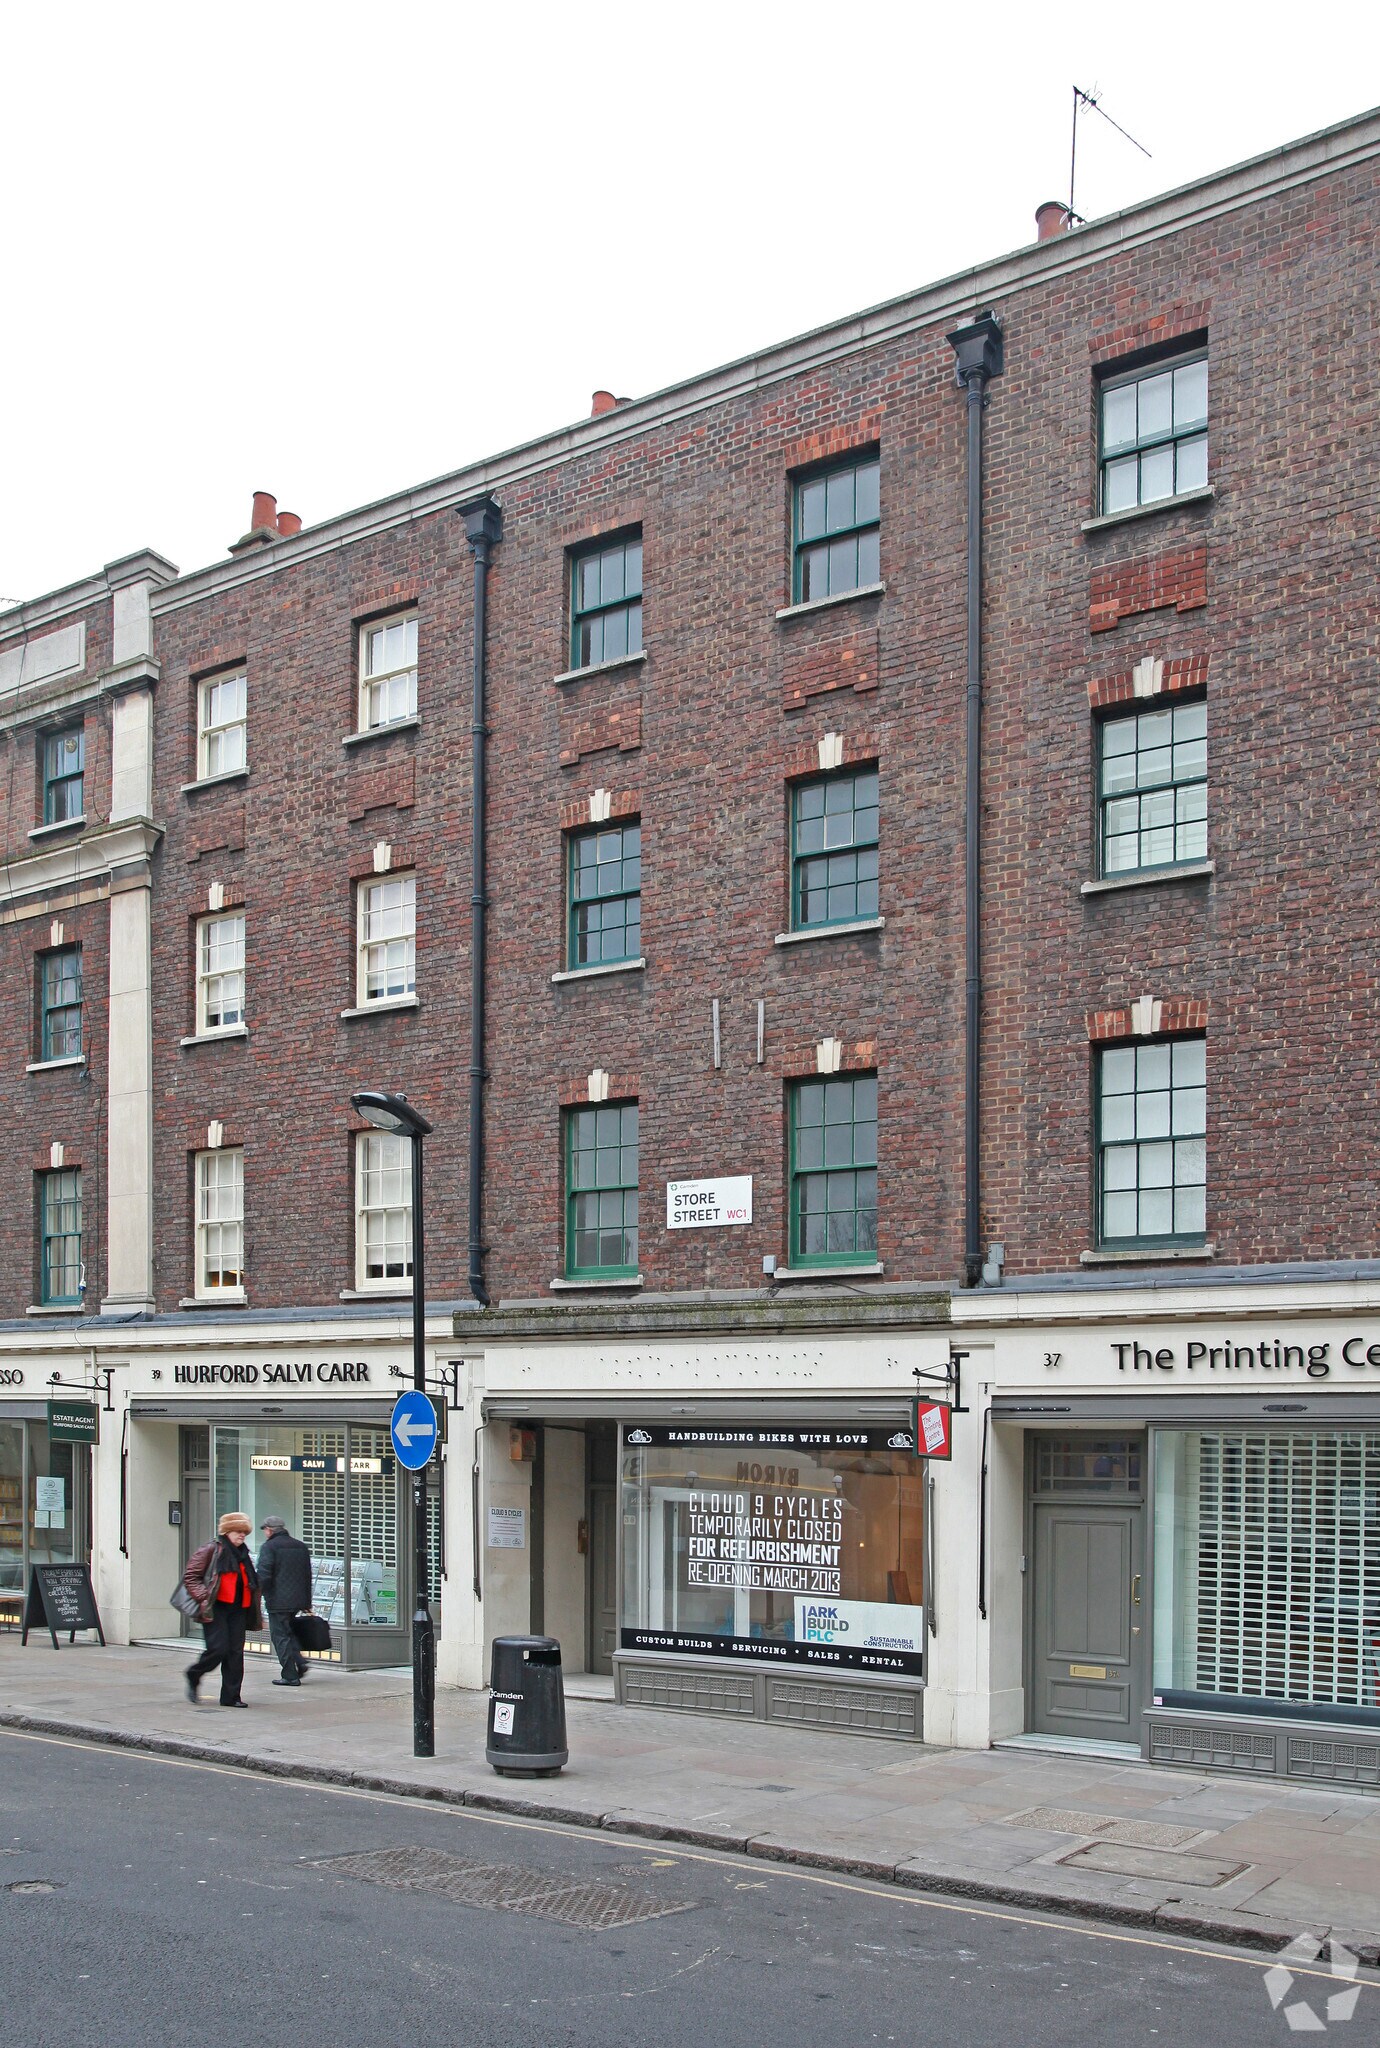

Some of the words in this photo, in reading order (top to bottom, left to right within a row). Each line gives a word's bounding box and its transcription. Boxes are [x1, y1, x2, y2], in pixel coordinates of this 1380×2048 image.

[674, 1192, 715, 1206] STORE
[673, 1208, 720, 1222] STREET
[726, 1209, 747, 1219] WC1
[1043, 1352, 1061, 1367] 37
[1110, 1341, 1175, 1370] The
[1187, 1339, 1329, 1378] Printing
[51, 1371, 60, 1380] 40
[151, 1369, 161, 1379] 39
[174, 1364, 258, 1383] HURFORD
[262, 1363, 312, 1382] SALVI
[316, 1362, 370, 1382] CARR
[388, 1364, 399, 1376] 39
[53, 1414, 74, 1422] ESTATE
[925, 1420, 941, 1432] Printing
[669, 1432, 754, 1442] HANDBUILDING
[759, 1433, 794, 1442] BIKES
[800, 1434, 829, 1443] WITH
[836, 1435, 868, 1444] LOVE
[927, 1431, 940, 1442] Centre
[252, 1459, 289, 1467] HURFORD
[302, 1460, 325, 1468] SALVI
[491, 1508, 504, 1516] CLOUD
[689, 1493, 744, 1515] CLOUD
[755, 1495, 764, 1516] 9
[774, 1497, 842, 1519] CYCLES
[690, 1514, 781, 1538] TEMPORARILY
[787, 1519, 842, 1543] CLOSED
[689, 1536, 716, 1558] FOR
[720, 1539, 841, 1565] REFURBISHMENT
[688, 1561, 760, 1586] RE-OPENING
[763, 1566, 806, 1590] MARCH
[811, 1571, 840, 1593] 2013
[807, 1606, 838, 1619] ARK
[807, 1618, 849, 1632] BUILD
[807, 1630, 834, 1642] PLC
[869, 1635, 914, 1645] SUSTAINABLE
[636, 1636, 674, 1645] CUSTOM
[678, 1639, 712, 1648] BUILDS
[732, 1644, 787, 1655] SERVICING
[807, 1650, 840, 1660] SALES
[861, 1655, 904, 1666] RENTAL
[863, 1640, 914, 1650] CONSTRUCTION
[493, 1690, 524, 1700] Camden
